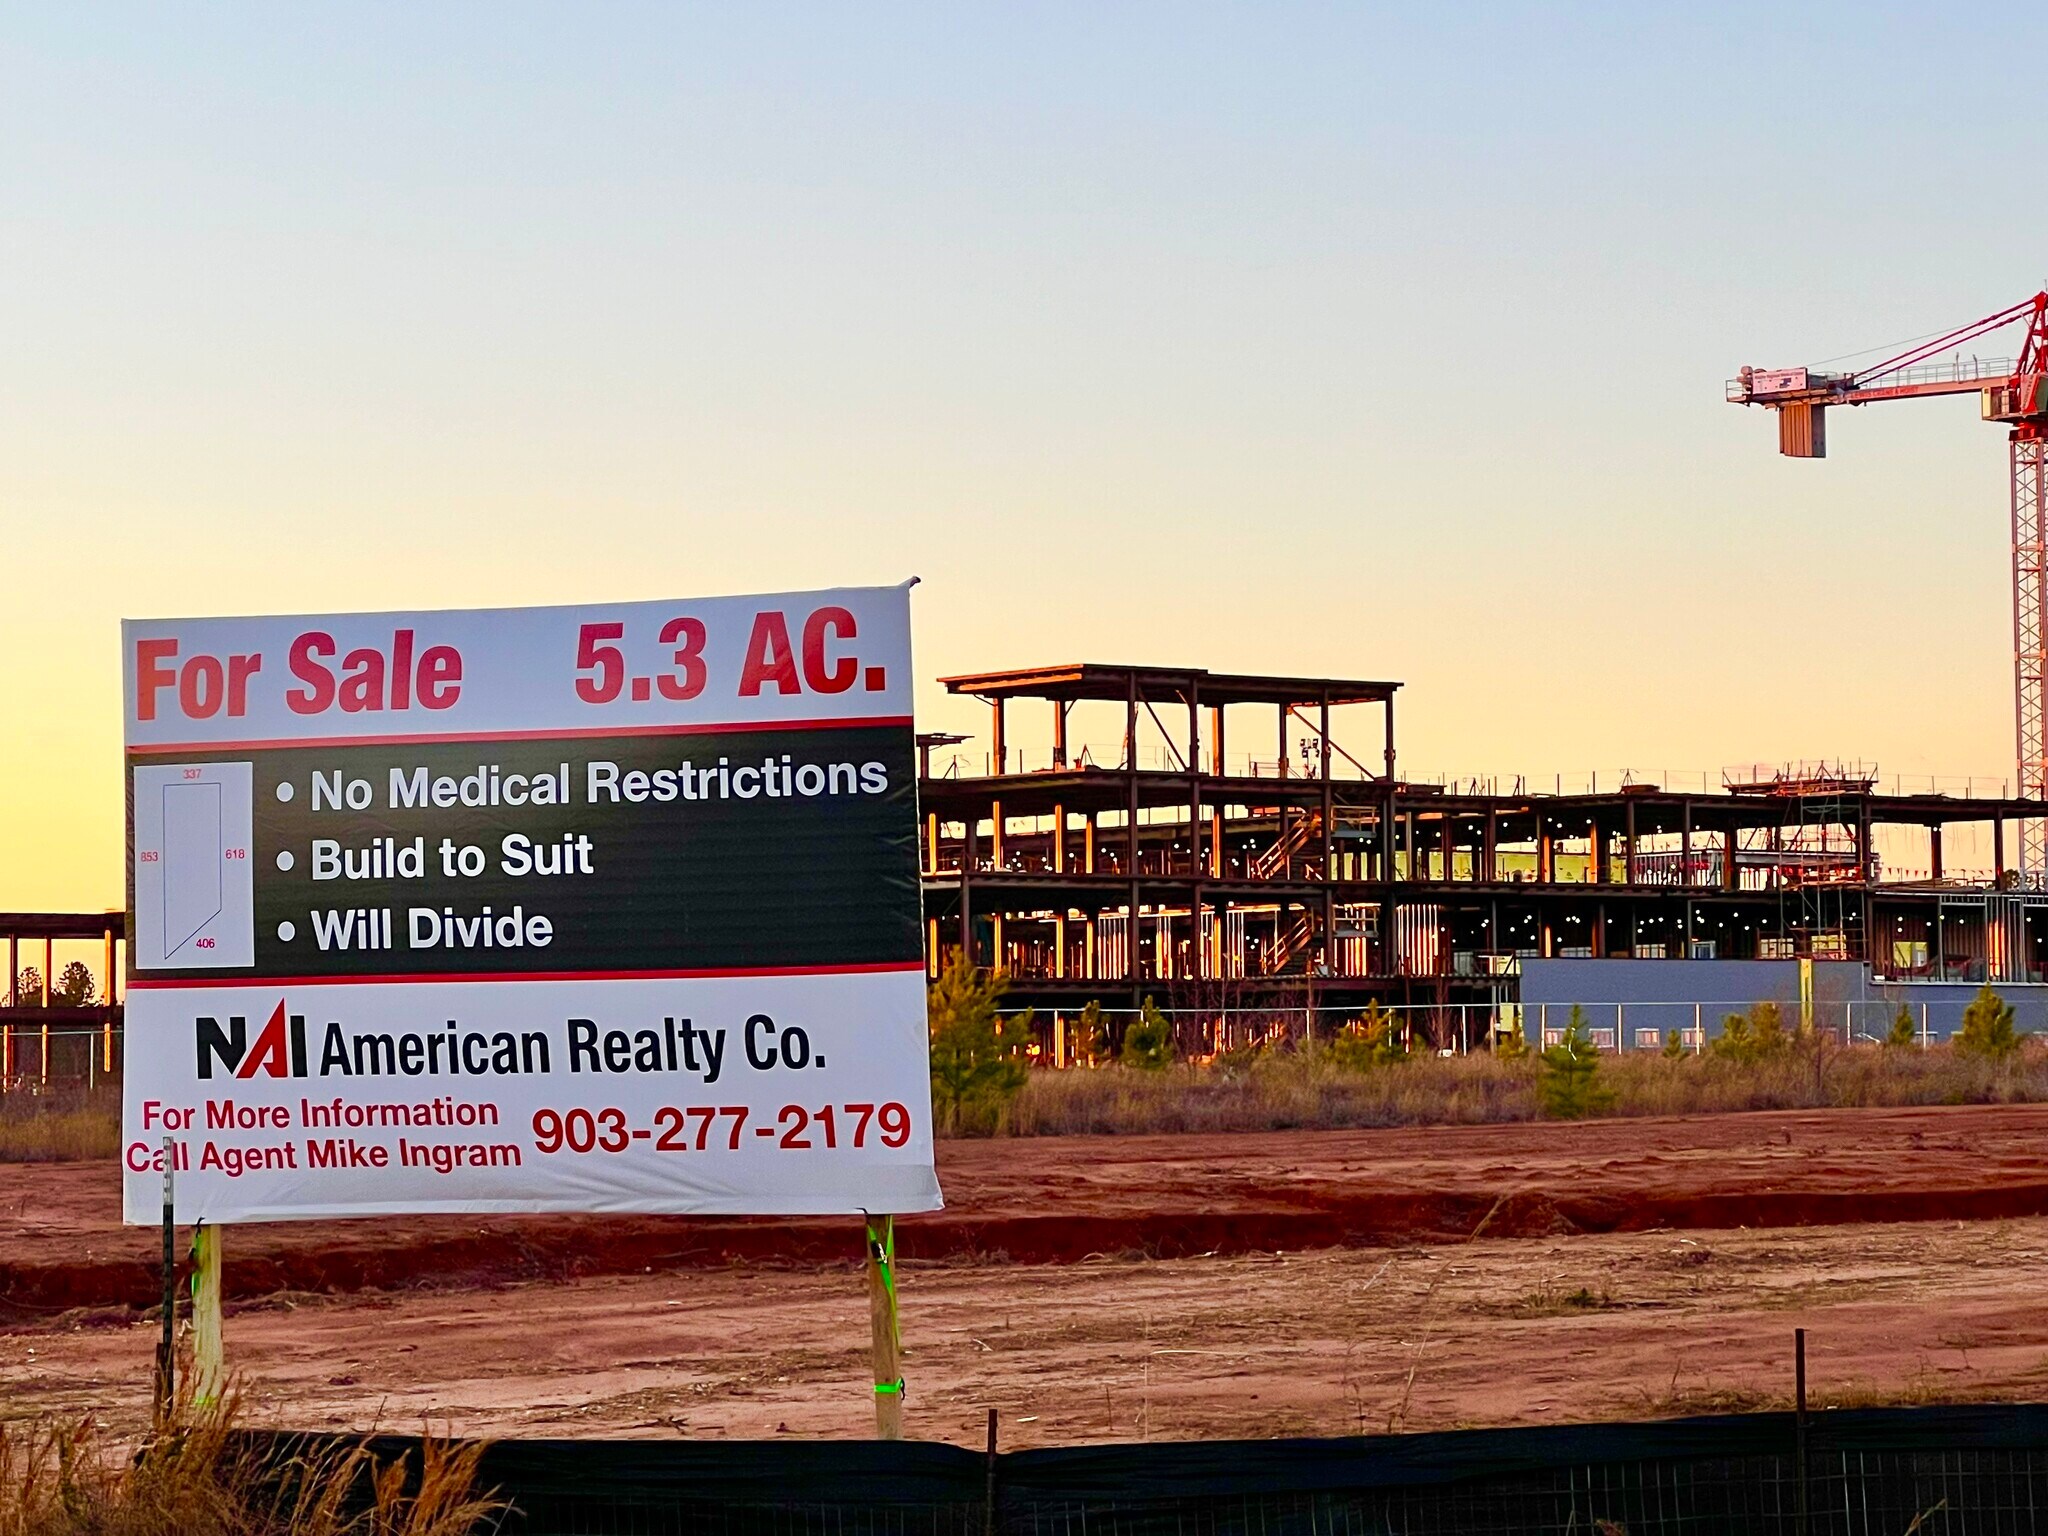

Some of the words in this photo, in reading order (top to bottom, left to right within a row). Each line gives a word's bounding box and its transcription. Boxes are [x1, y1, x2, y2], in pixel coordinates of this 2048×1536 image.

[137, 638, 261, 720] For
[286, 629, 462, 714] Sale
[576, 618, 707, 704] 5.3
[738, 607, 885, 697] AC.
[183, 769, 202, 779] 337
[312, 770, 372, 810] No
[390, 763, 569, 808] Medical
[588, 755, 887, 802] Restrictions
[140, 852, 159, 861] 853
[225, 849, 245, 859] 618
[313, 837, 424, 880] Build
[439, 839, 485, 876] to
[501, 833, 593, 875] Suit
[196, 938, 215, 949] 406
[311, 909, 391, 950] Will
[409, 906, 552, 948] Divide
[196, 999, 307, 1079] NAI
[320, 1021, 550, 1076] American
[568, 1018, 725, 1083] Realty
[745, 1015, 825, 1070] Co.
[143, 1100, 194, 1130] For
[206, 1100, 289, 1129] More
[301, 1097, 498, 1127] Information
[533, 1102, 911, 1153] 903-277-2179
[201, 1142, 296, 1178] Agent
[307, 1139, 388, 1168] Mike
[400, 1139, 522, 1174] Ingram
